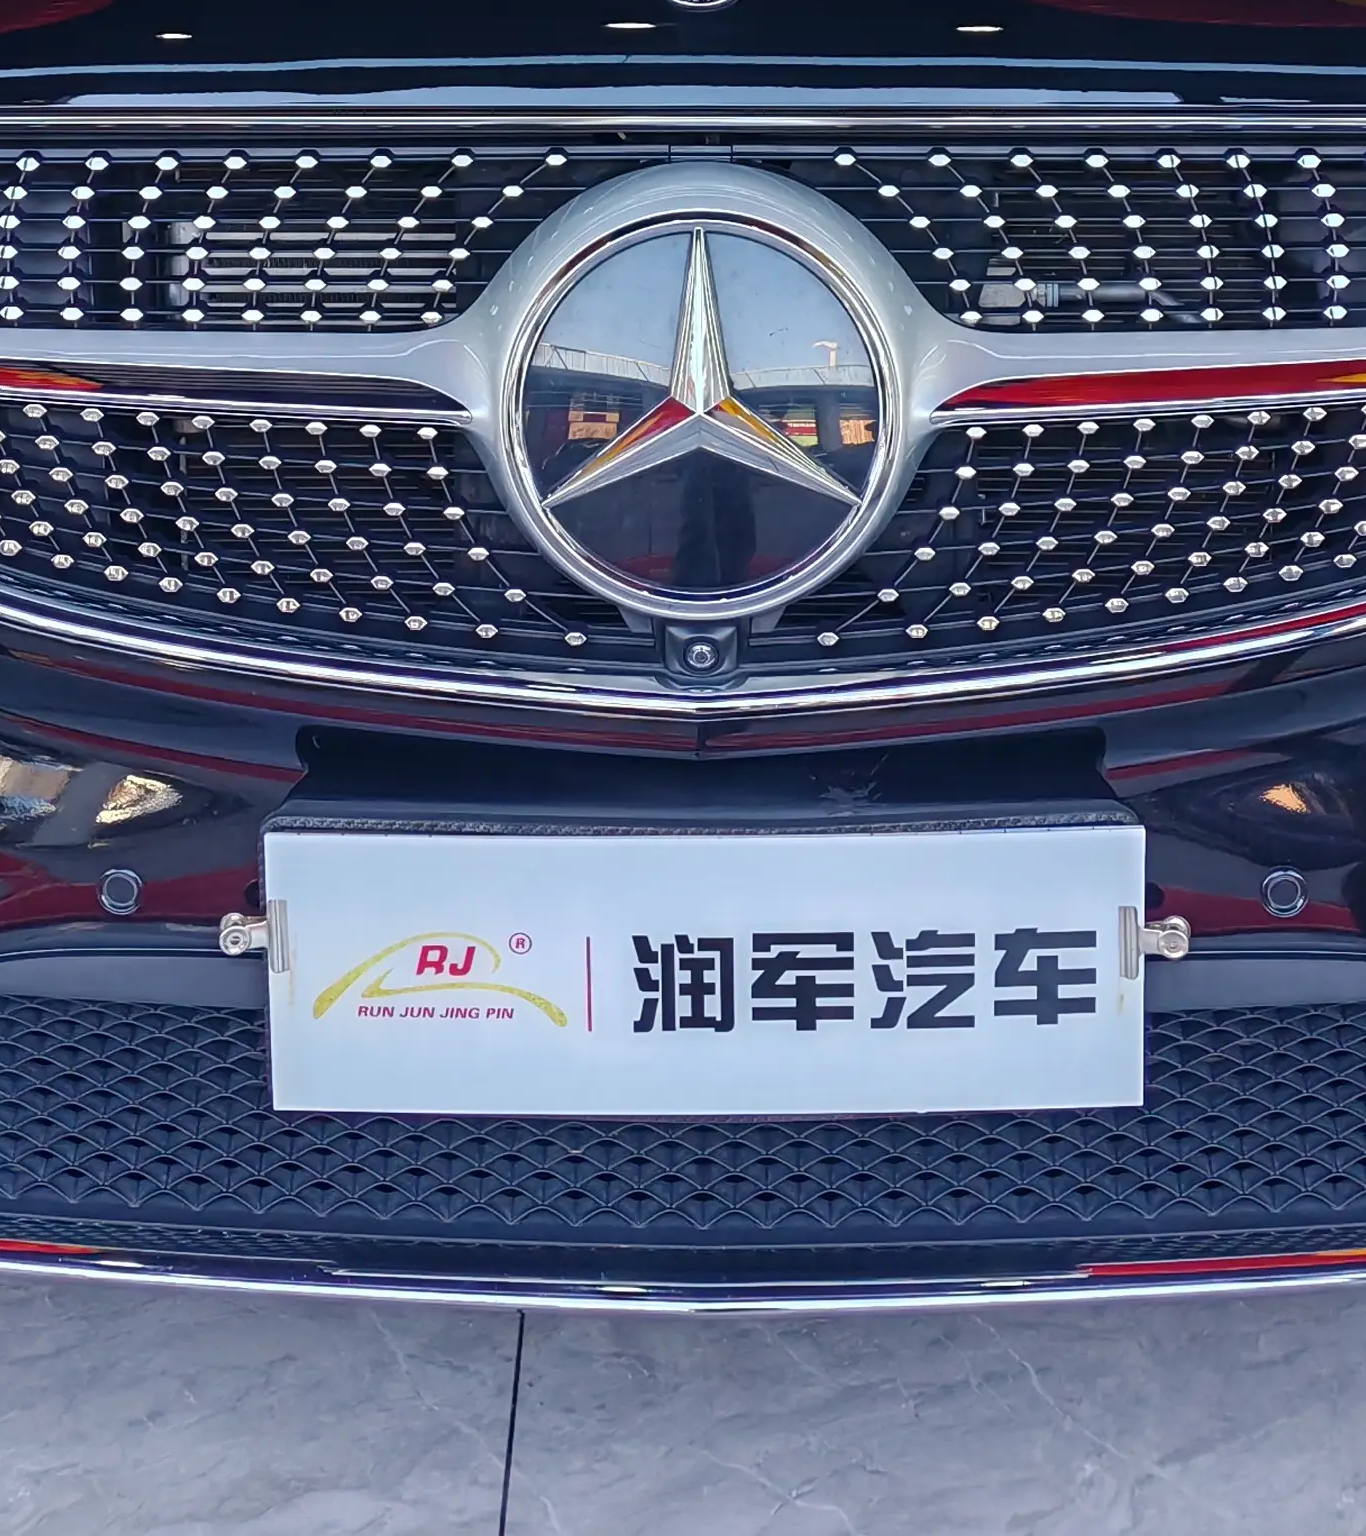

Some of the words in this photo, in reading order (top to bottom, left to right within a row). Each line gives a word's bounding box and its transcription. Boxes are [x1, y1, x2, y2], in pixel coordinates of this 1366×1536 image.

[415, 944, 477, 977] RJ
[631, 927, 1097, 1033] 润军汽车
[357, 1005, 395, 1018] RUN
[399, 1006, 436, 1019] JUN
[439, 1007, 481, 1020] JING
[485, 1007, 515, 1020] PIN
